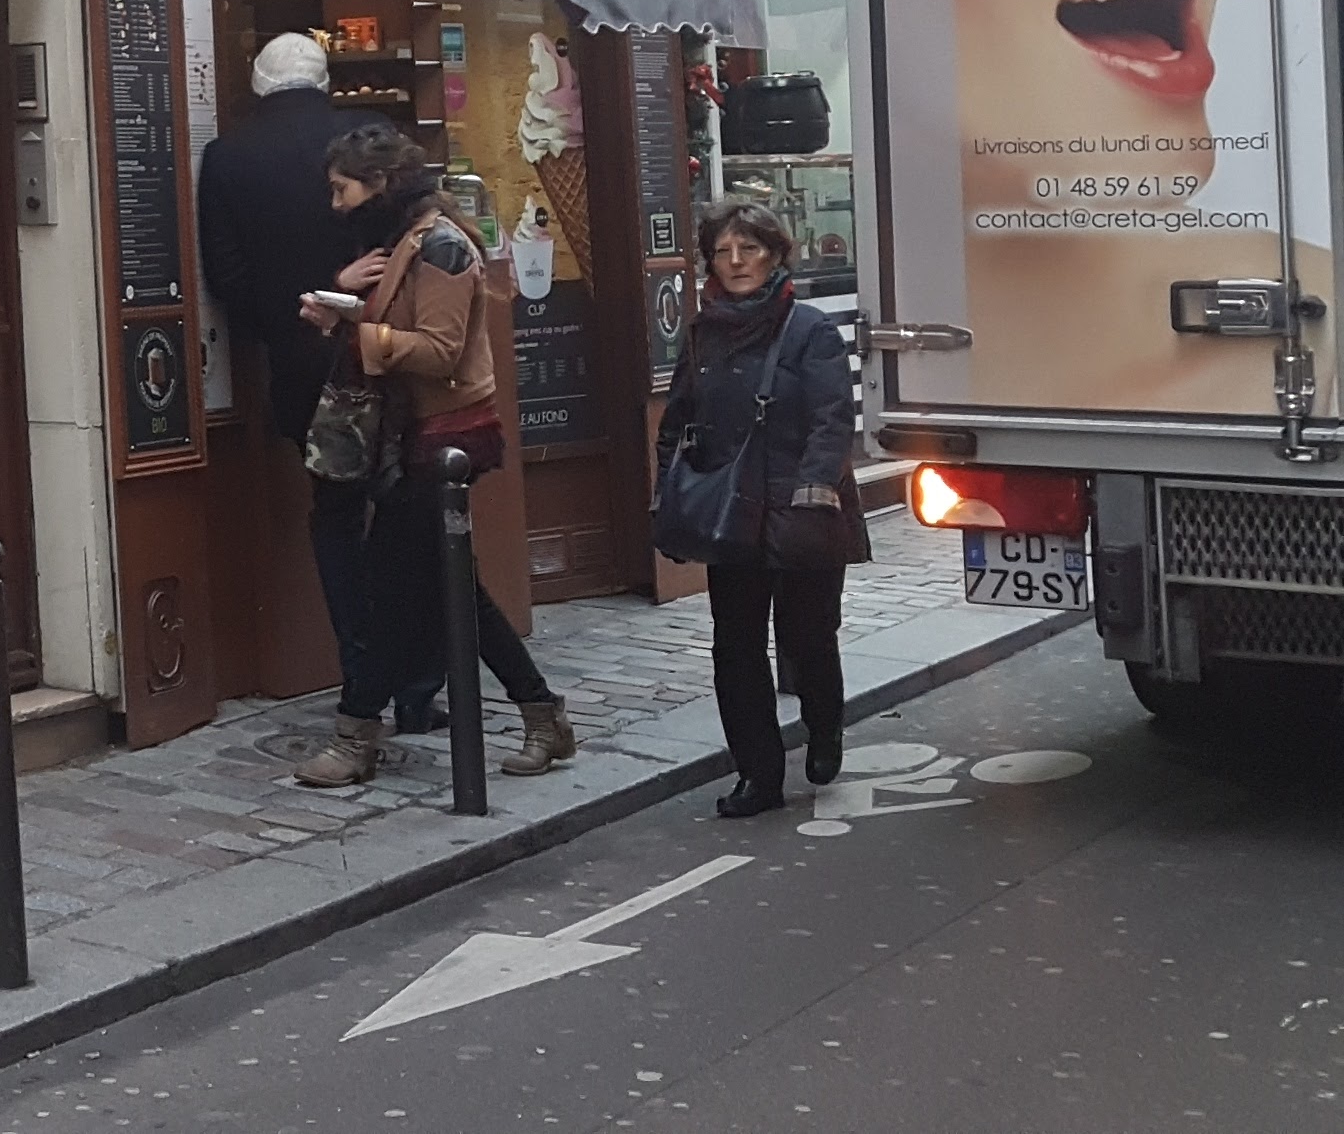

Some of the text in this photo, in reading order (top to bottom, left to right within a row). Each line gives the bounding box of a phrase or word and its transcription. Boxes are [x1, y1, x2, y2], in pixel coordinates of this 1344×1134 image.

[974, 130, 1269, 156] Livraisons du lundi au samedi
[1035, 175, 1199, 198] 01 48 59 61 59
[974, 207, 1270, 234] contact@creta-gel.com
[967, 567, 1086, 606] 779-SY
